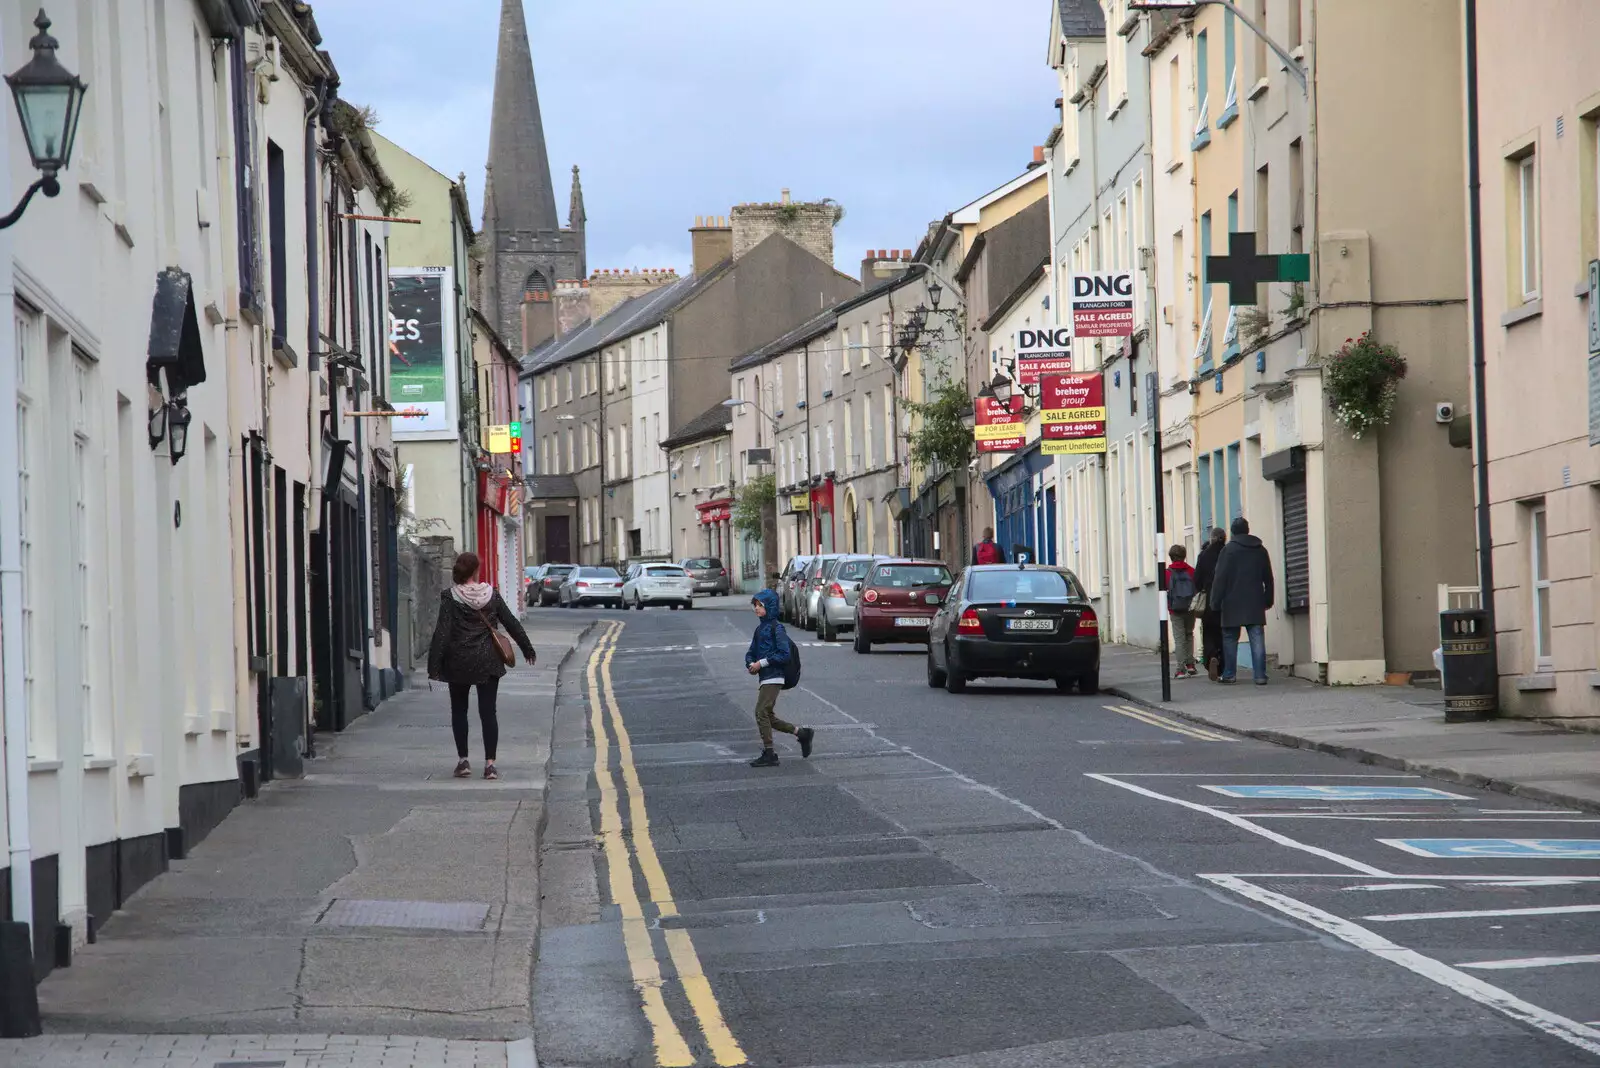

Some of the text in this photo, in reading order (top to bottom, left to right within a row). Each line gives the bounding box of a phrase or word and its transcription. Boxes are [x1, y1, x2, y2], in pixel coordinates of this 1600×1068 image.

[1074, 275, 1132, 297] DNG
[1074, 312, 1133, 322] SALE AGREED
[391, 319, 420, 340] ES
[1020, 328, 1070, 348] DNG
[1040, 361, 1070, 369] AGREED
[1060, 377, 1083, 385] oates
[1055, 387, 1090, 396] breheny
[1061, 397, 1086, 407] group
[1046, 410, 1101, 421] SALE AGREED
[992, 417, 1011, 425] group
[1069, 442, 1105, 450] Unaffected
[881, 568, 890, 576] N
